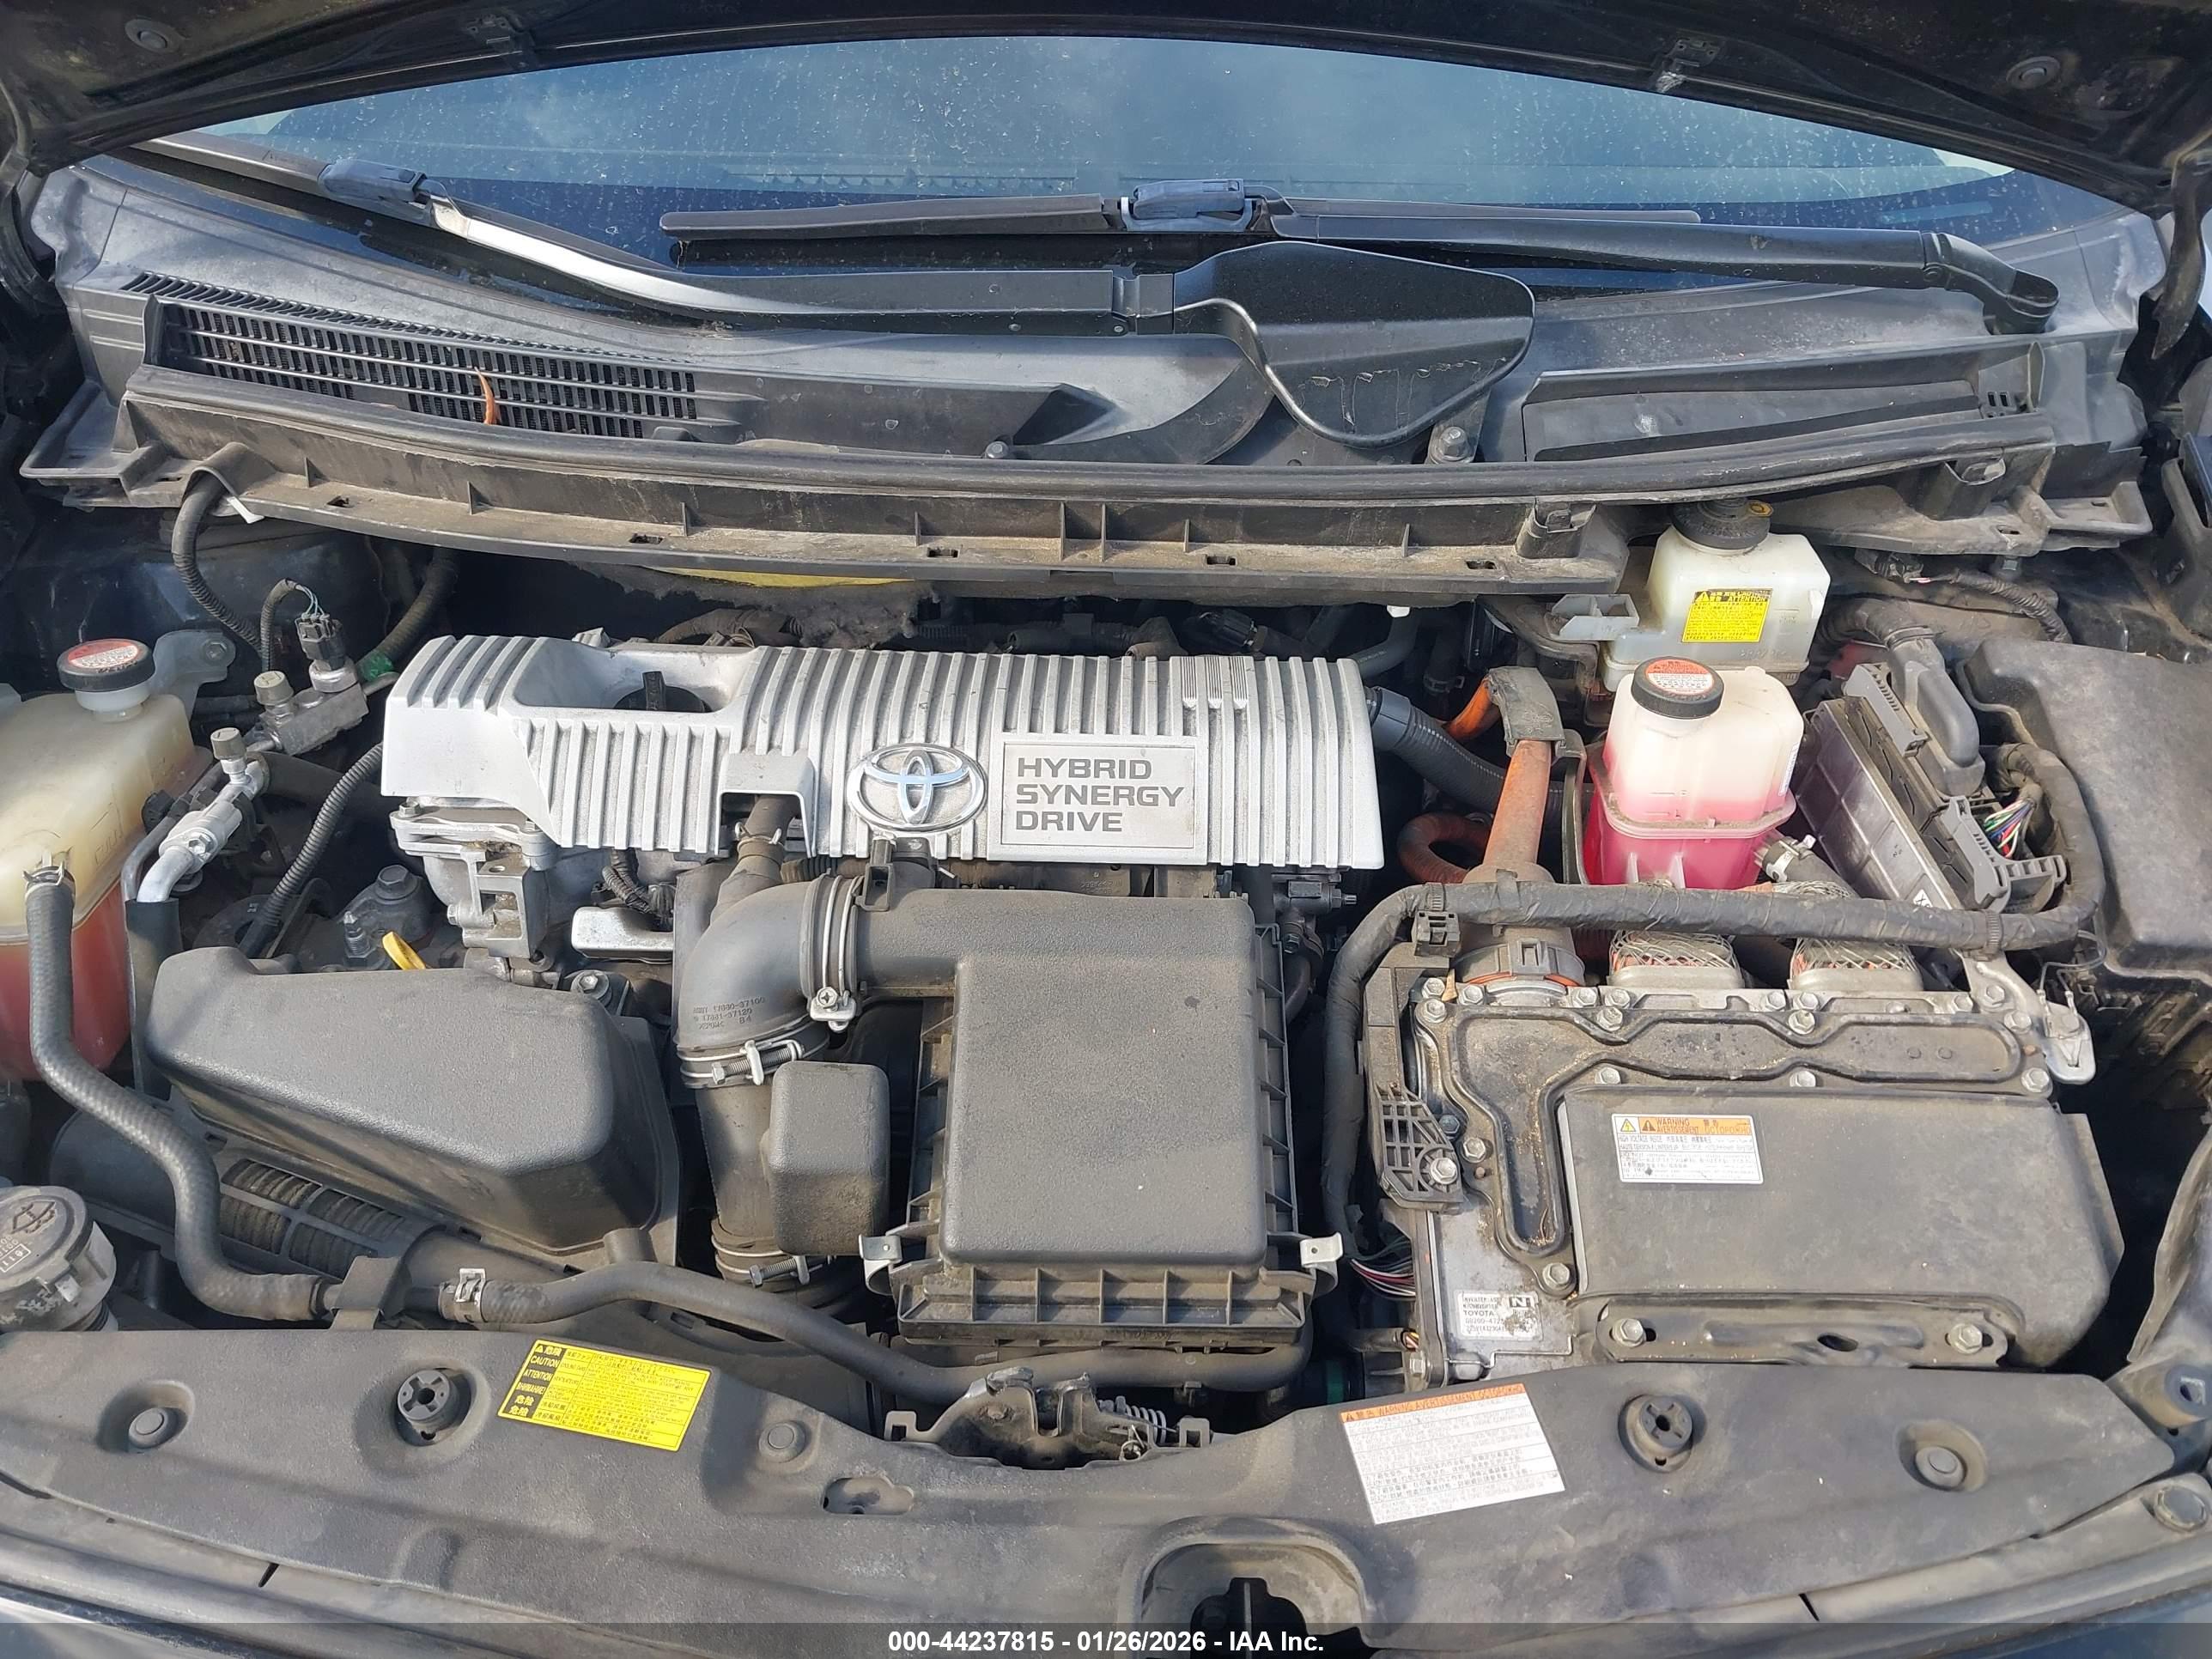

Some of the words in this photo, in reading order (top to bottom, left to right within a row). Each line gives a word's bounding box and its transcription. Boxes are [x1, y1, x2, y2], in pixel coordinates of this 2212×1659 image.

[1017, 757, 1152, 780] HYBRID
[1016, 784, 1185, 807] SYNERGY
[1016, 811, 1123, 832] DRIVE
[1656, 1117, 1690, 1127] WARNING
[531, 1355, 560, 1368] CAUTION
[523, 1369, 554, 1382] ATTENTION
[1379, 1402, 1414, 1416] WARNING
